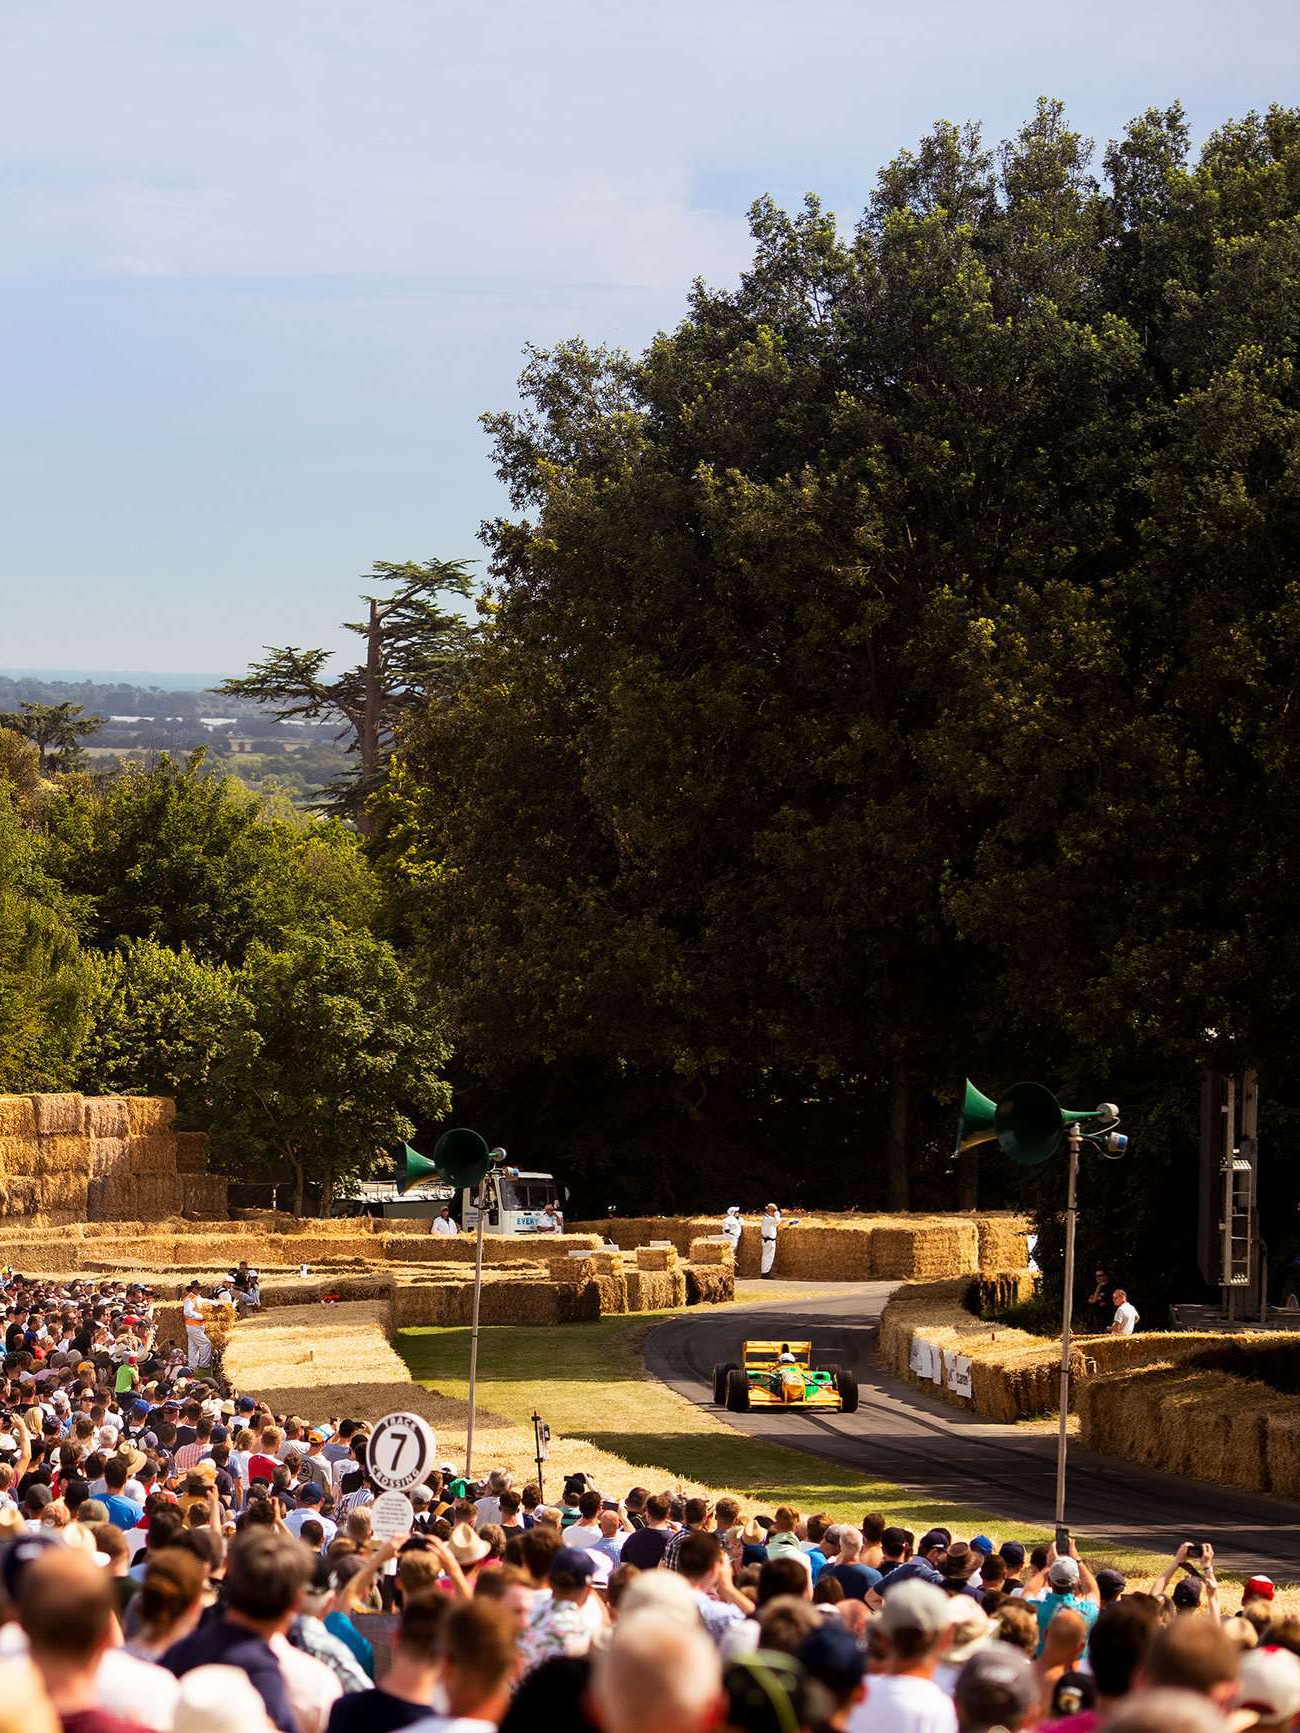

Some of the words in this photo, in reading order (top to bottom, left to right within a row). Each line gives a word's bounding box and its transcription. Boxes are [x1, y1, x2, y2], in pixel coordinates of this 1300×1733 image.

[384, 1416, 417, 1432] TRACK
[390, 1433, 407, 1471] 7
[371, 1464, 420, 1488] CROSSING
